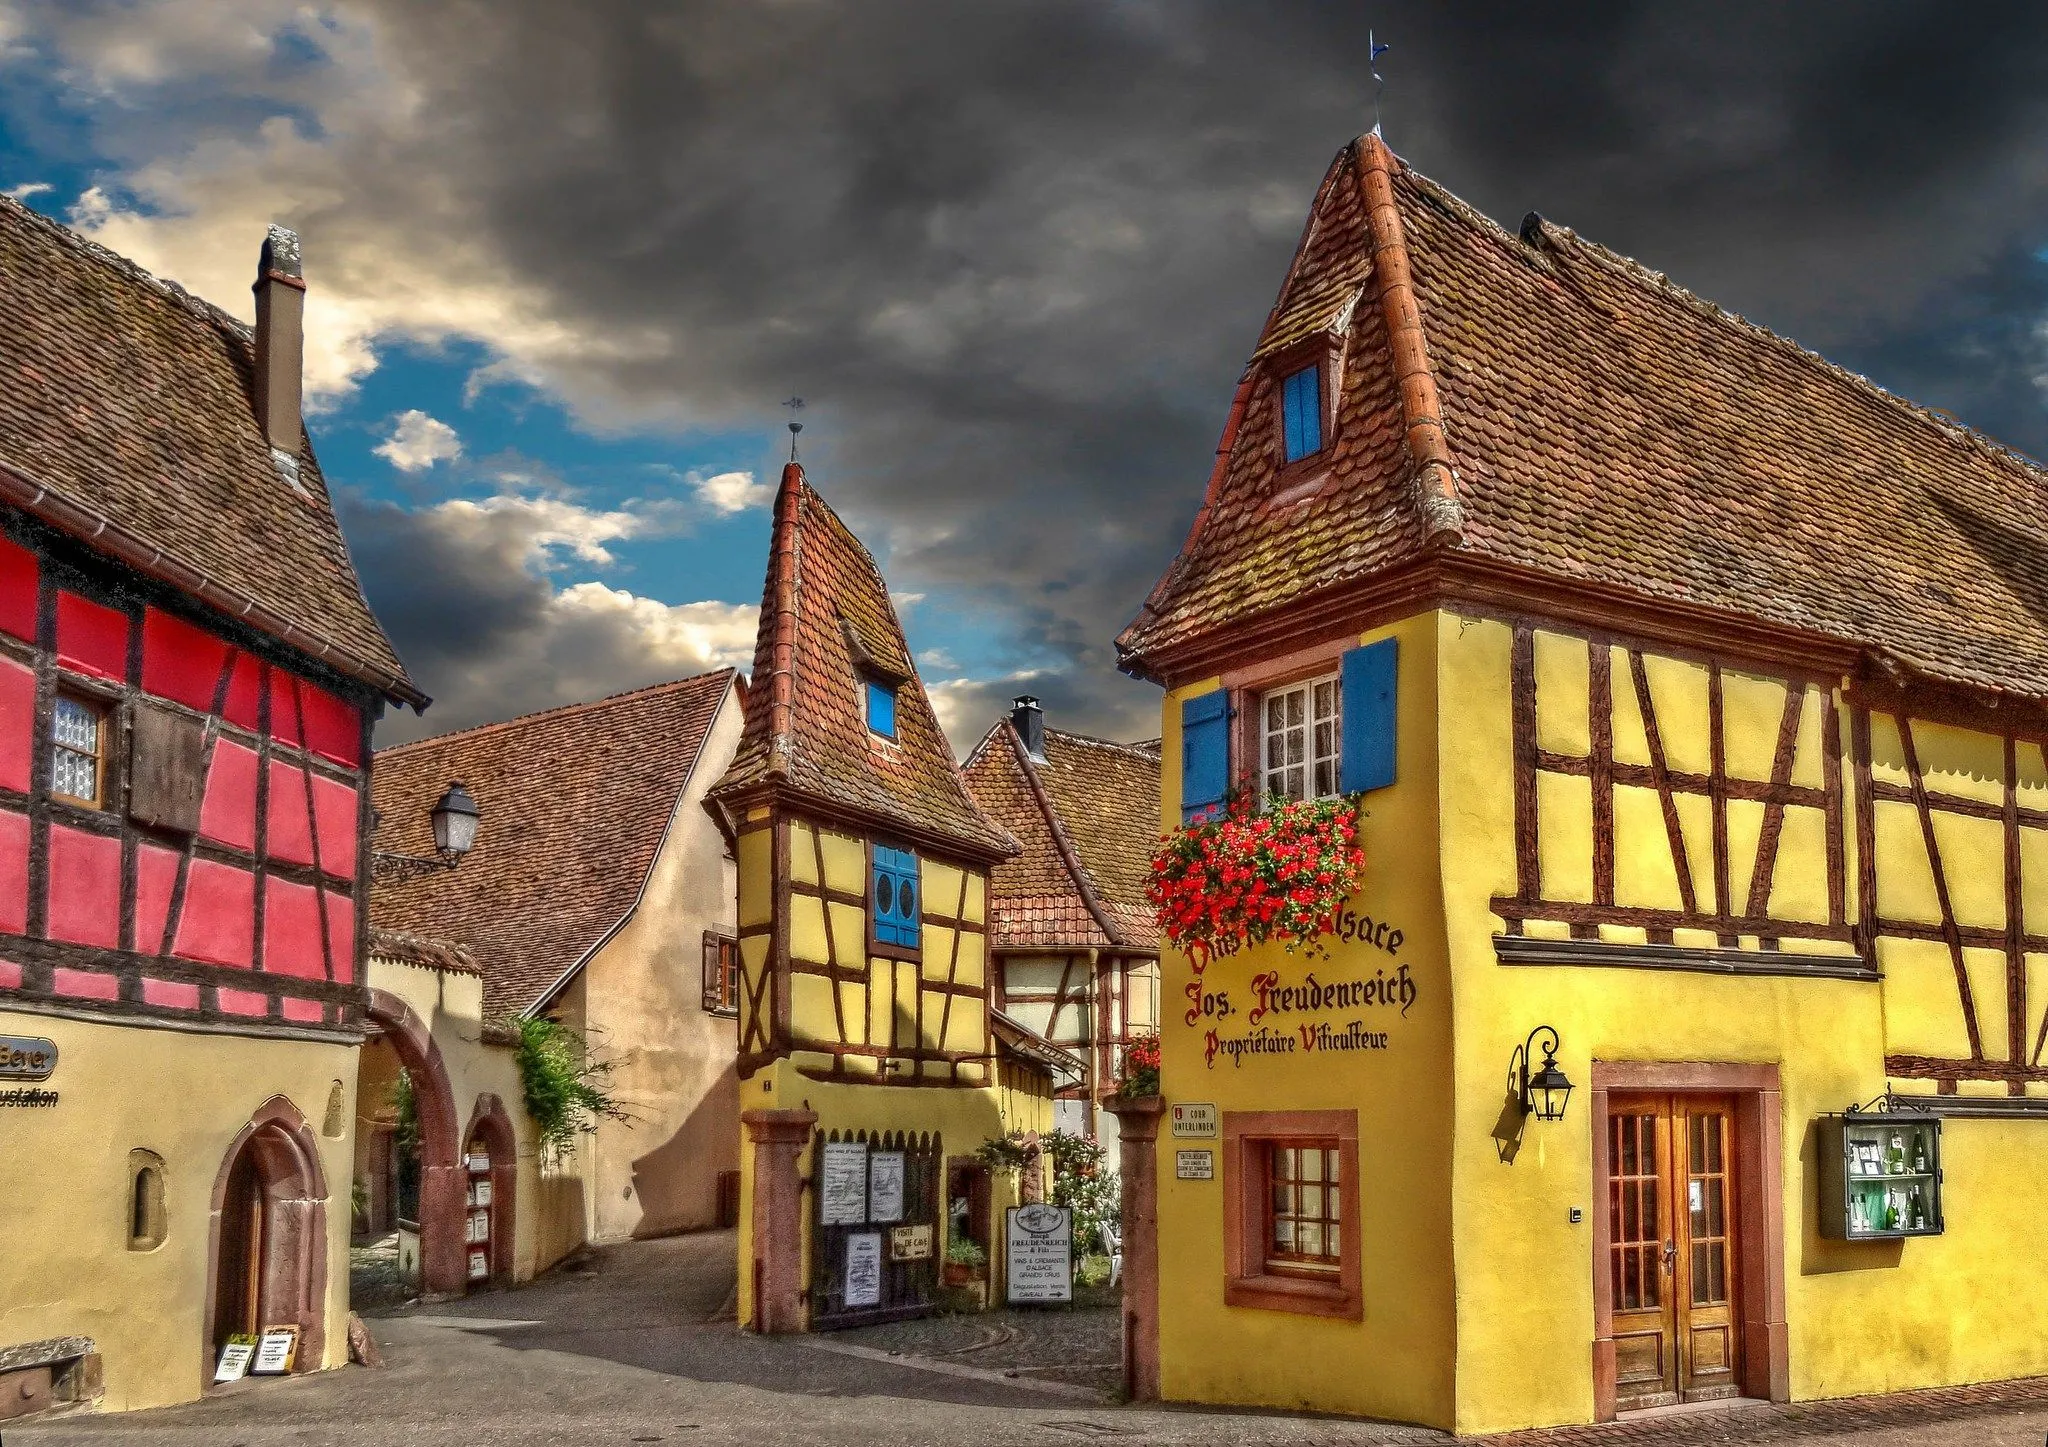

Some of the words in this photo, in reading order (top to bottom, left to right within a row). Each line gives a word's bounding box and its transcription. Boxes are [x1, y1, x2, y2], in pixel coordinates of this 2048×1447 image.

[1249, 964, 1416, 1025] Freudenreich
[1204, 1027, 1294, 1069] Propriétaire
[1190, 1110, 1206, 1118] COUR
[1174, 1122, 1214, 1131] UNTERLINDEN
[913, 1237, 928, 1247] CAVE
